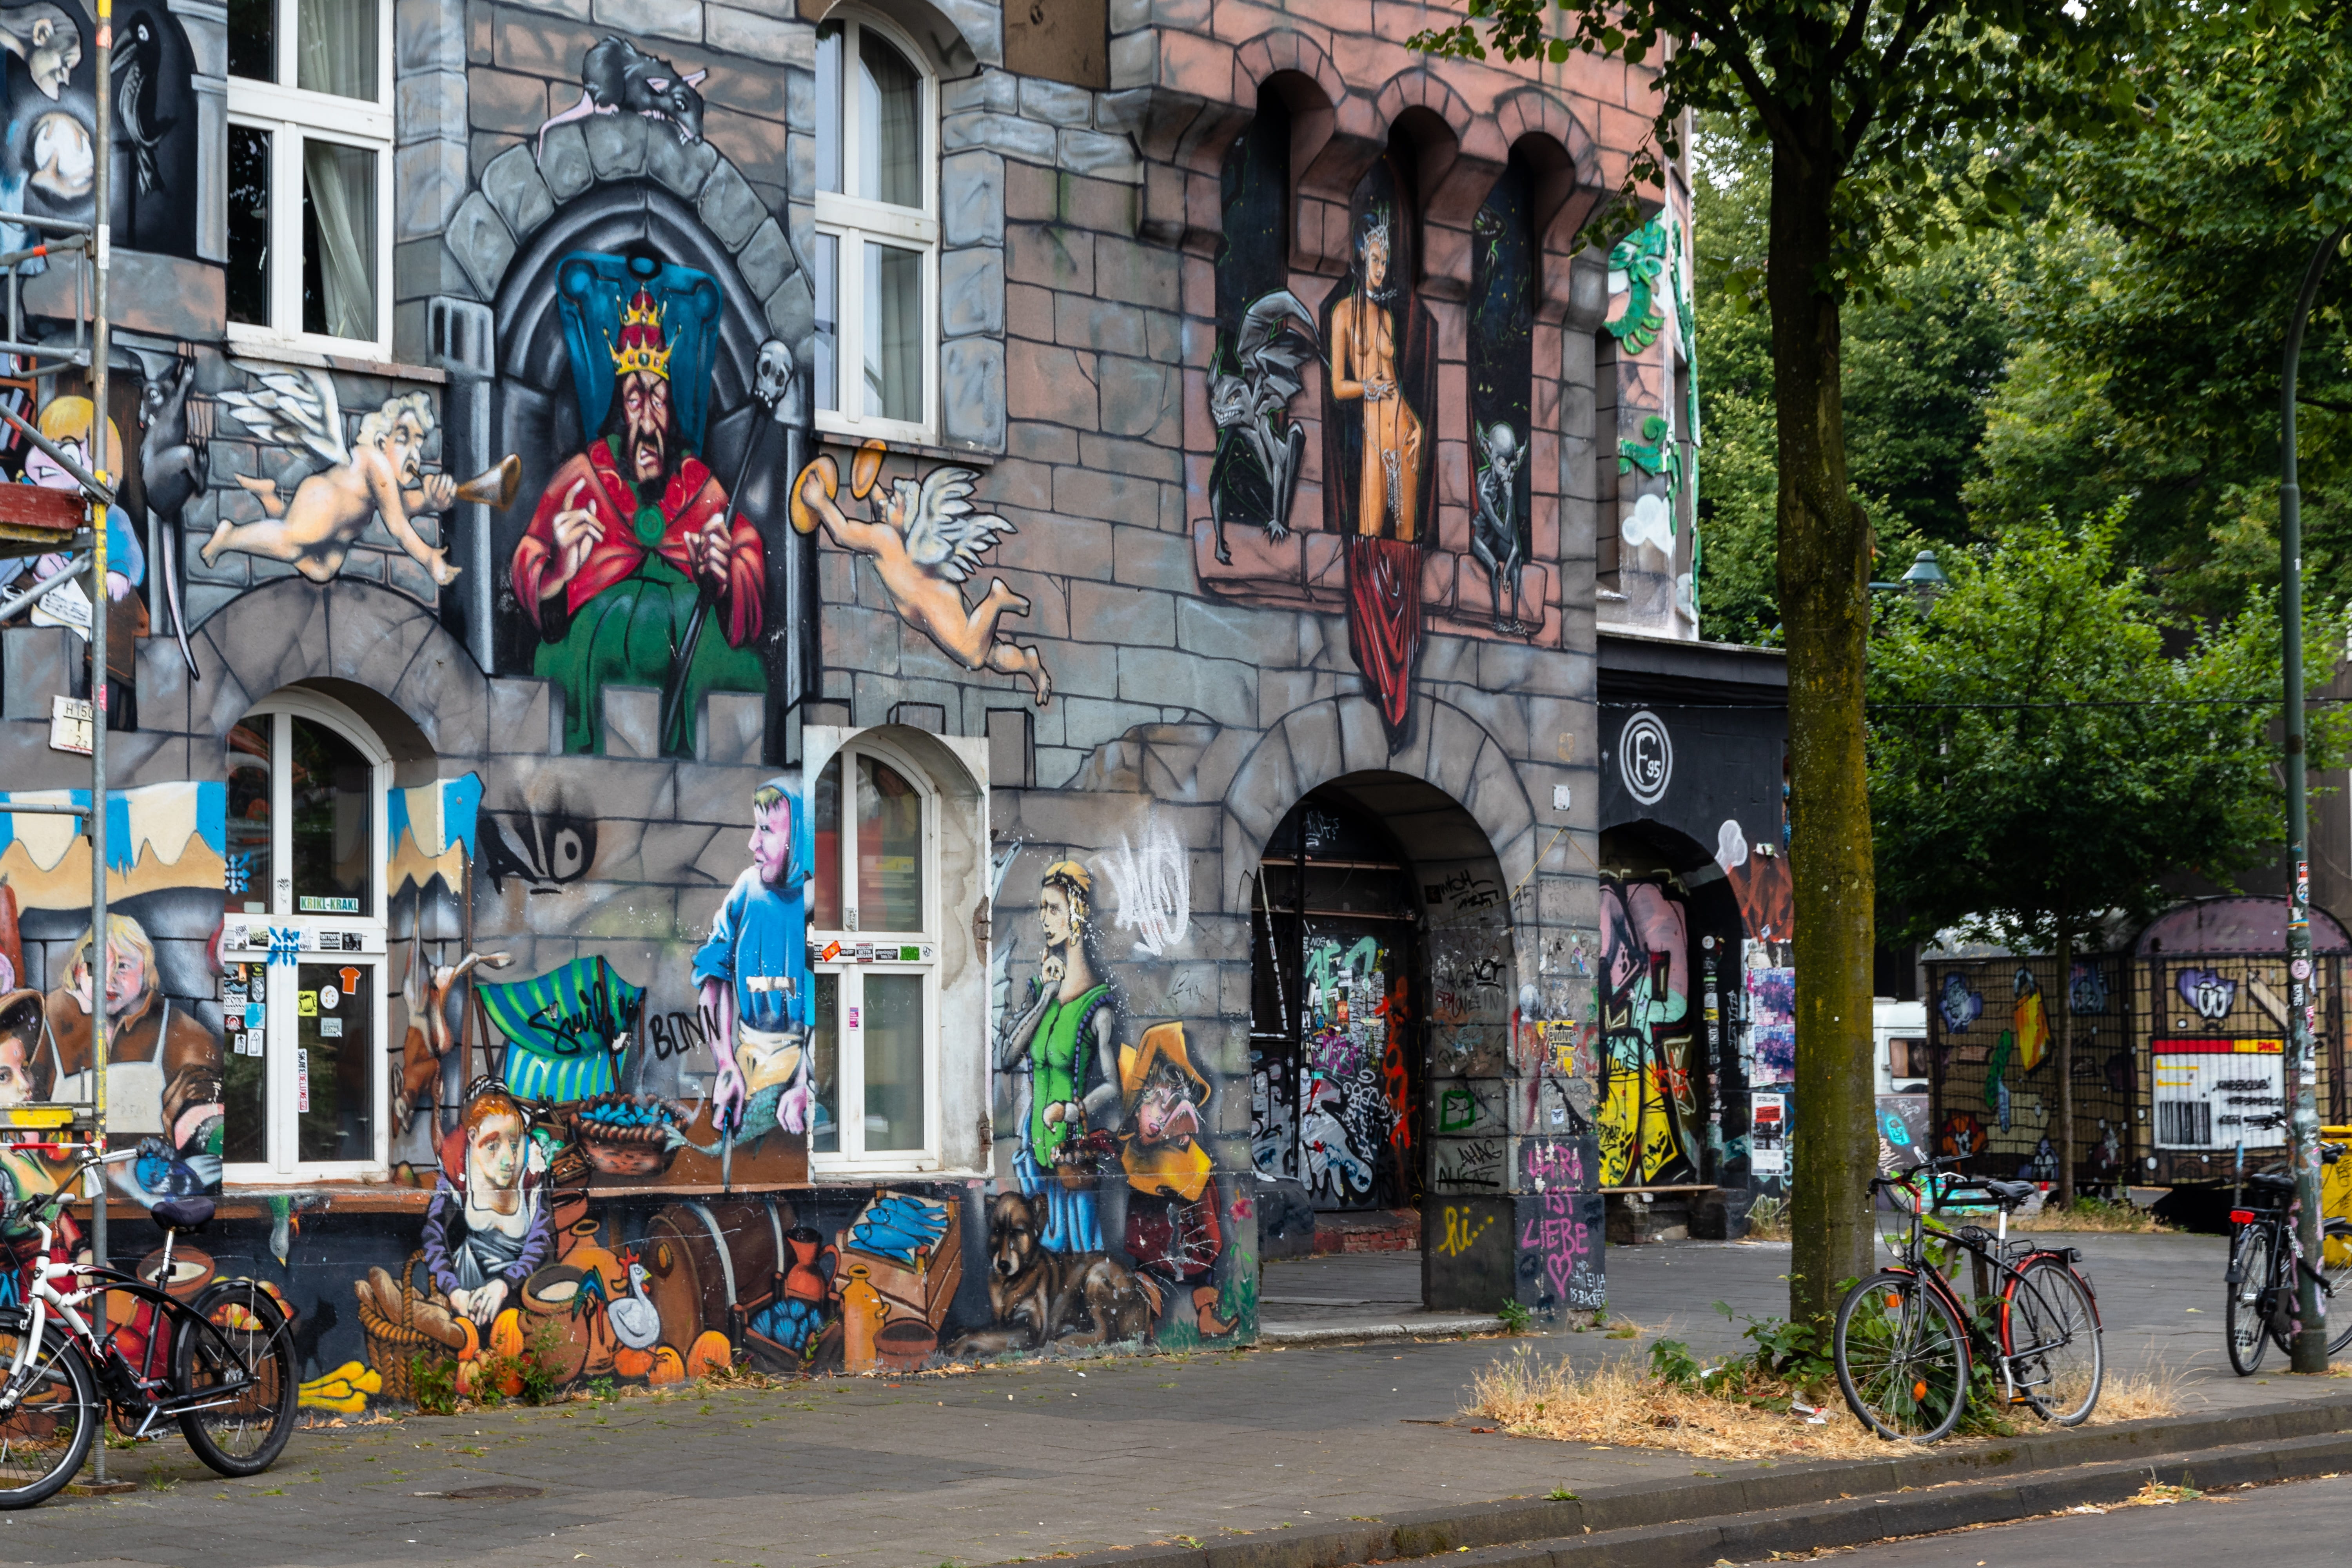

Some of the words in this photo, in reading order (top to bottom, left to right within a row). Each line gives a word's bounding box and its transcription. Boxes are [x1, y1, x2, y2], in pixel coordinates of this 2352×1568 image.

[301, 898, 358, 910] KRIKL-KRAKL
[650, 1004, 720, 1061] BONN
[1545, 1186, 1576, 1215] IST
[1521, 1218, 1588, 1255] LIEBE
